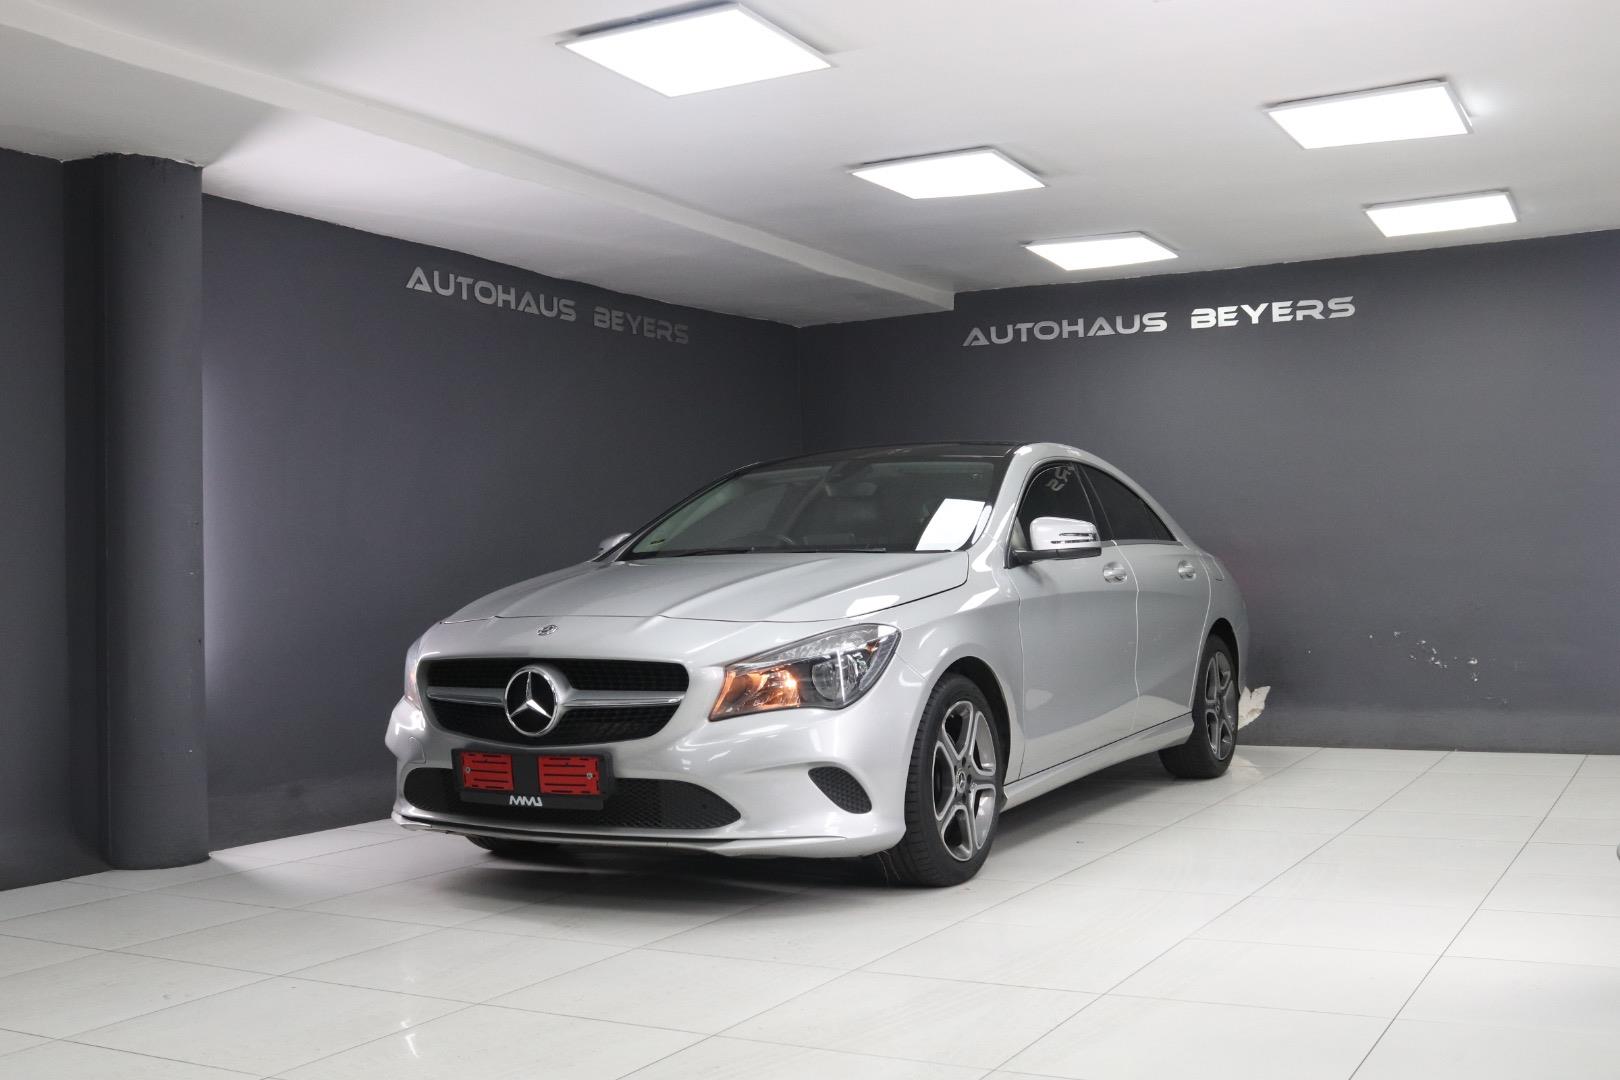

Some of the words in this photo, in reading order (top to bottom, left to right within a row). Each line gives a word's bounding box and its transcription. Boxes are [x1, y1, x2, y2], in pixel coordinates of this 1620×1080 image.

[406, 266, 576, 321] AUTOHAUS
[593, 306, 689, 344] BEYERS
[962, 311, 1168, 346] AUTOHAUS
[1190, 296, 1356, 329] BEYERS
